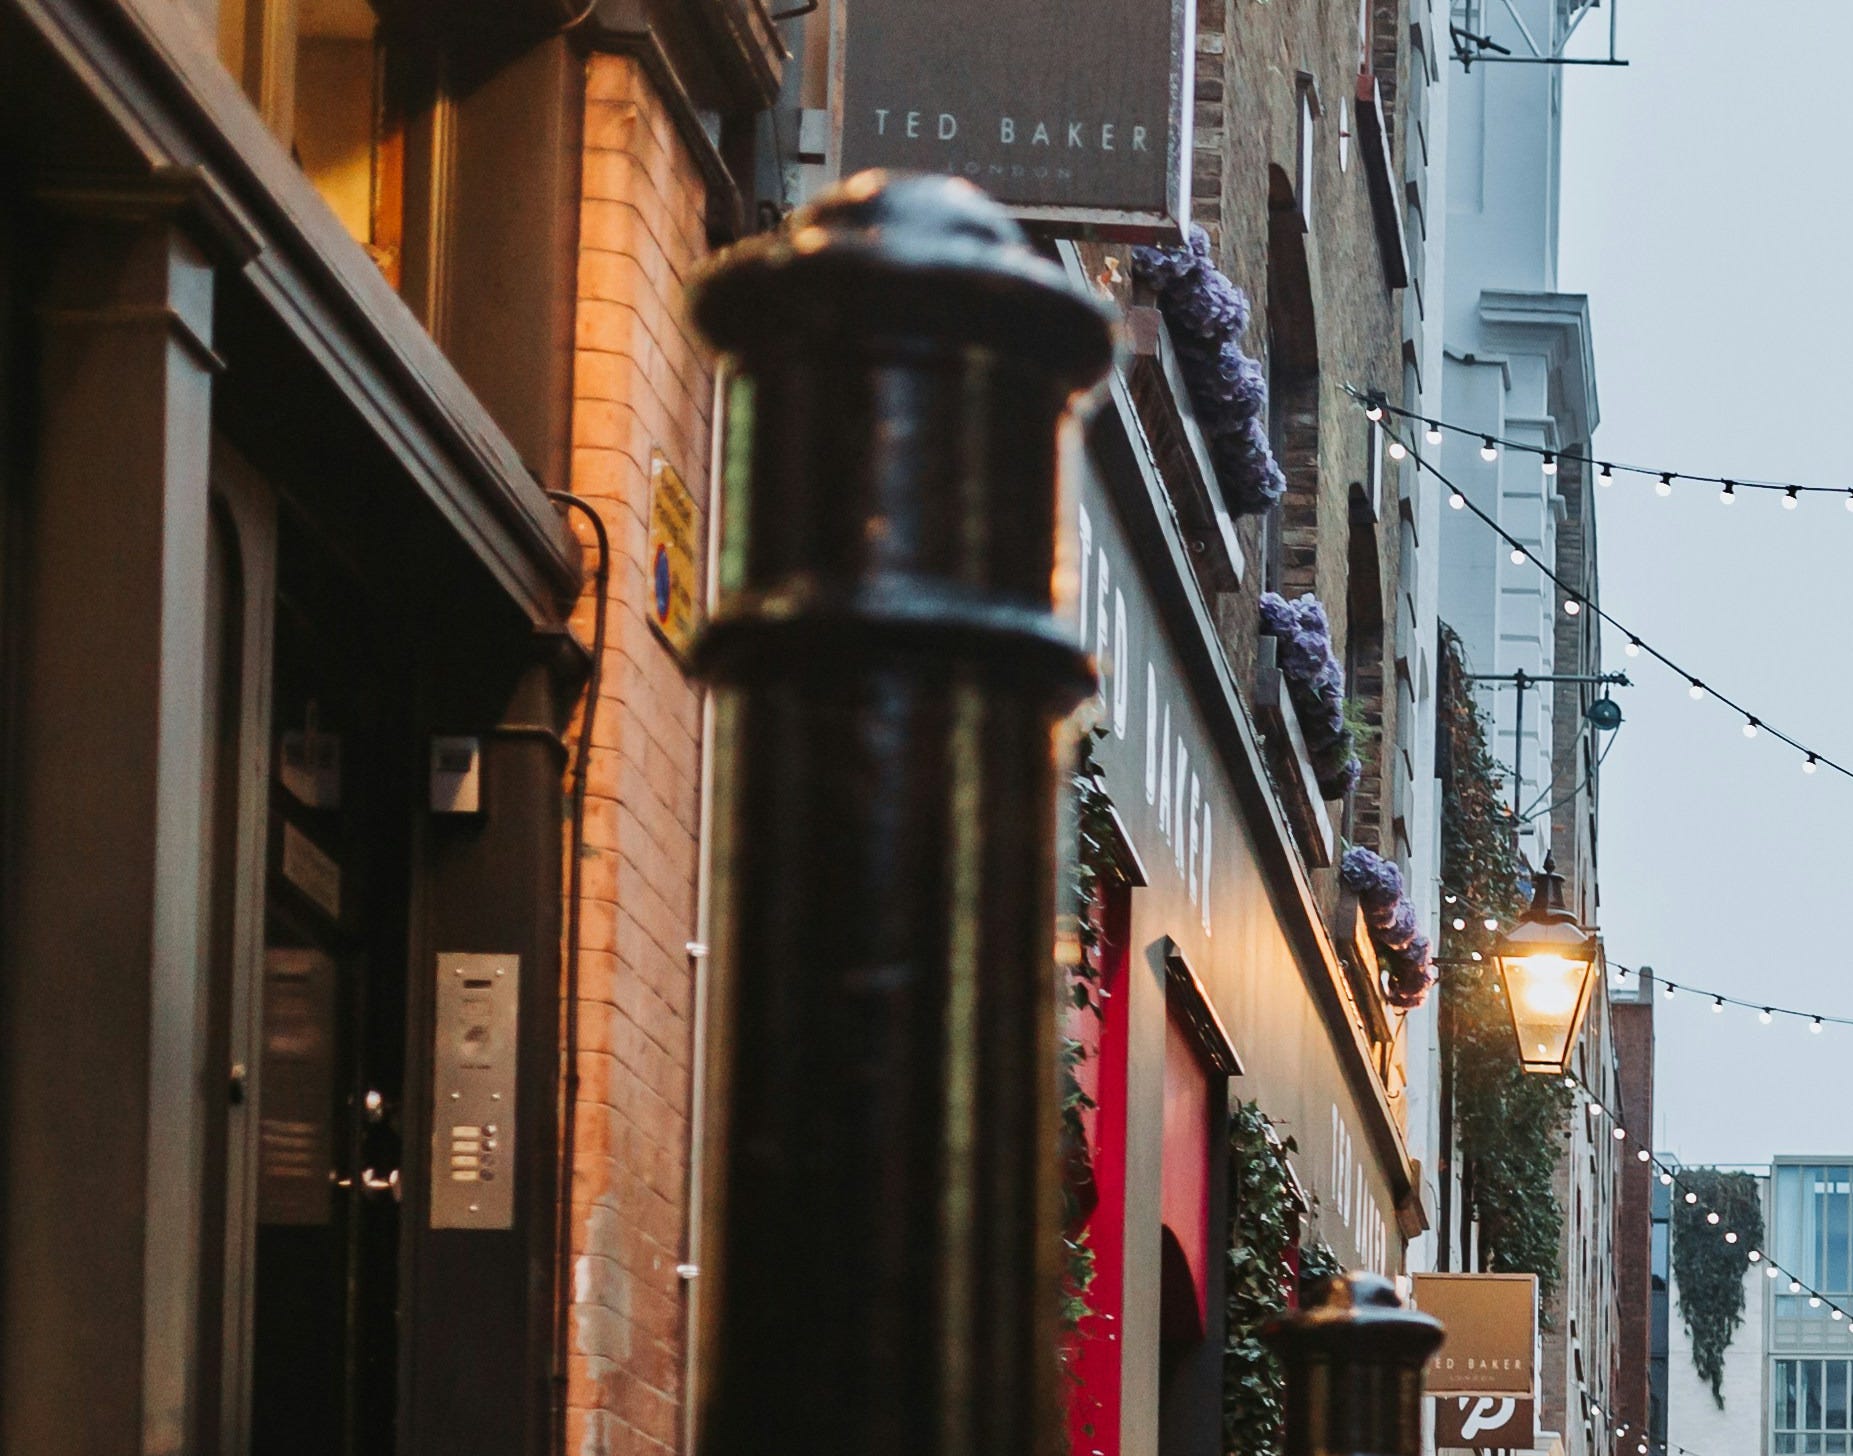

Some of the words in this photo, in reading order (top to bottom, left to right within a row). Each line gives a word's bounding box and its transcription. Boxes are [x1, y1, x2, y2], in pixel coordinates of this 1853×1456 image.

[875, 109, 958, 140] TED
[1000, 117, 1148, 152] BAKER
[949, 161, 1071, 180] LONDON
[1468, 1358, 1522, 1370] BAKER
